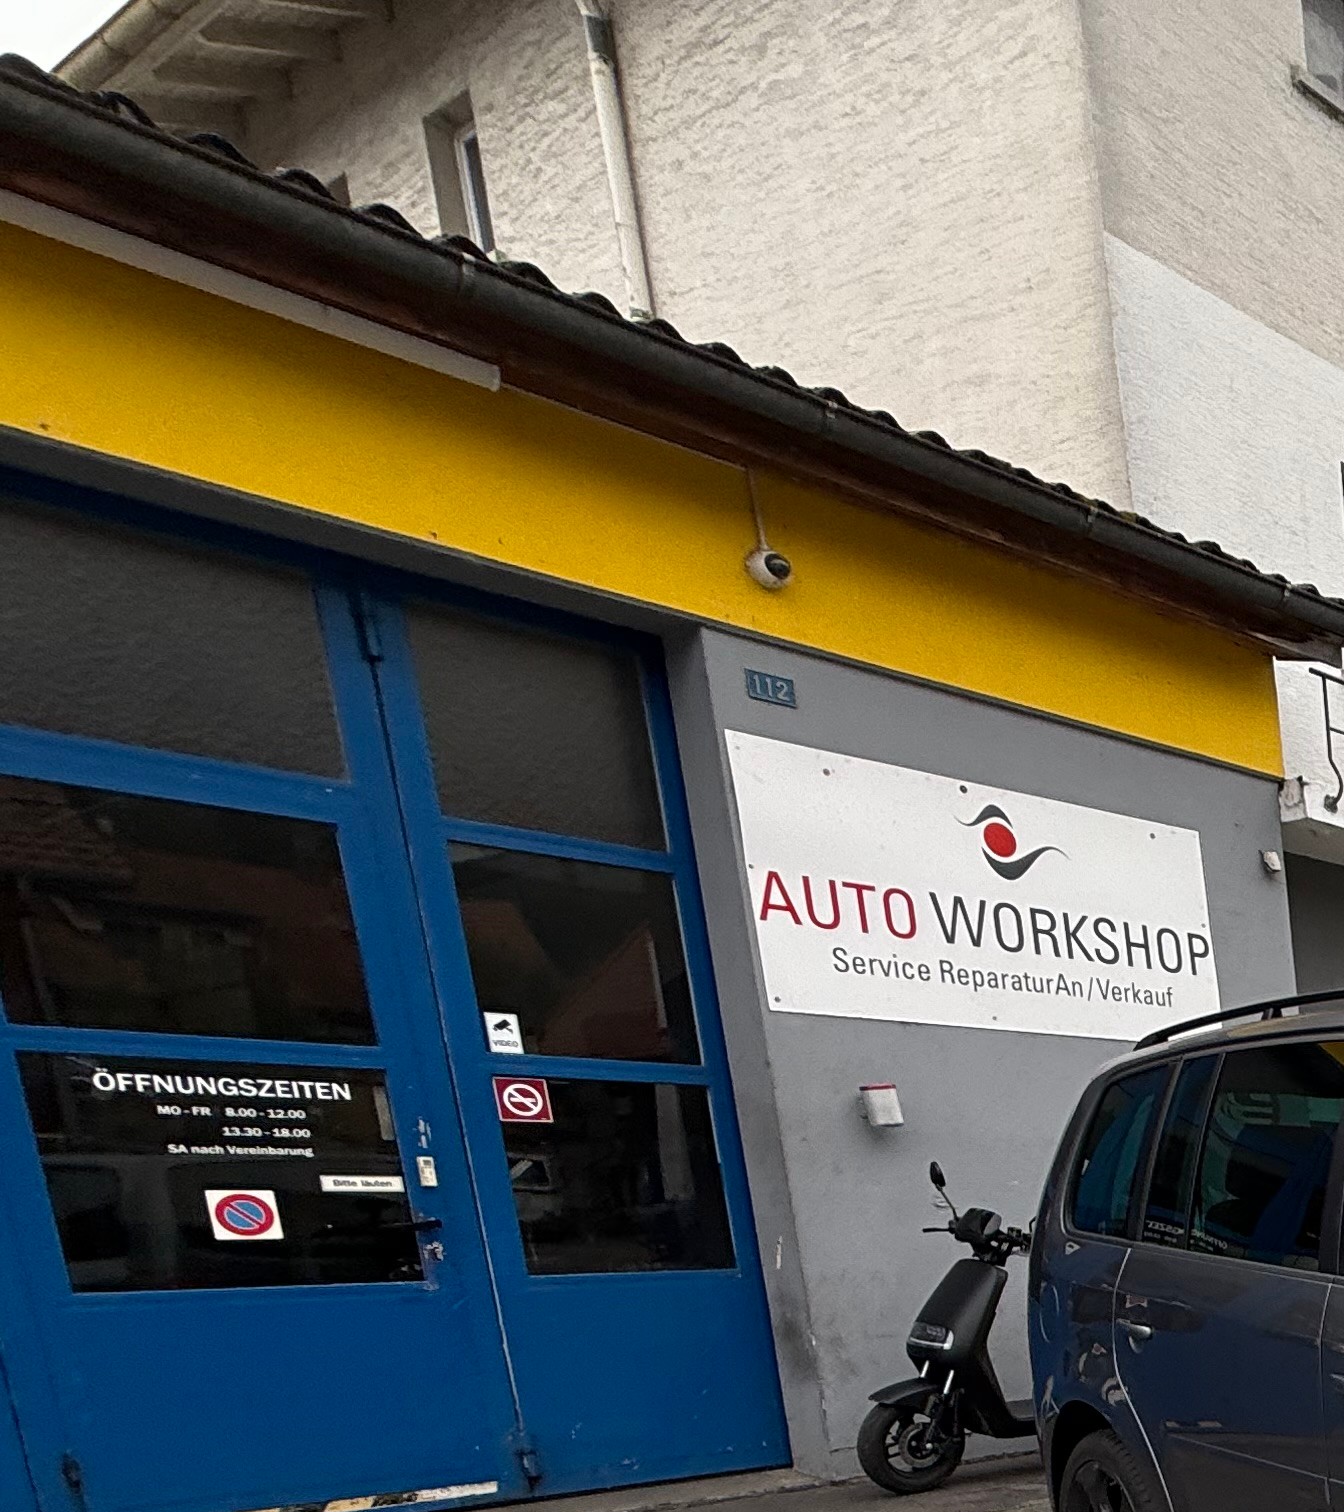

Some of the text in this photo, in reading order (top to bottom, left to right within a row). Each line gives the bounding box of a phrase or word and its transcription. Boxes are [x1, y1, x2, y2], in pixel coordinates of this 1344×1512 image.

[753, 674, 791, 702] 112
[759, 870, 1210, 976] AUTO WORKSHOP
[832, 946, 932, 982] Service
[492, 1039, 520, 1048] VIDEO
[92, 1066, 352, 1101] ÖFFNUNGSZEITEN
[167, 1143, 315, 1158] SA nach Vereinbarung
